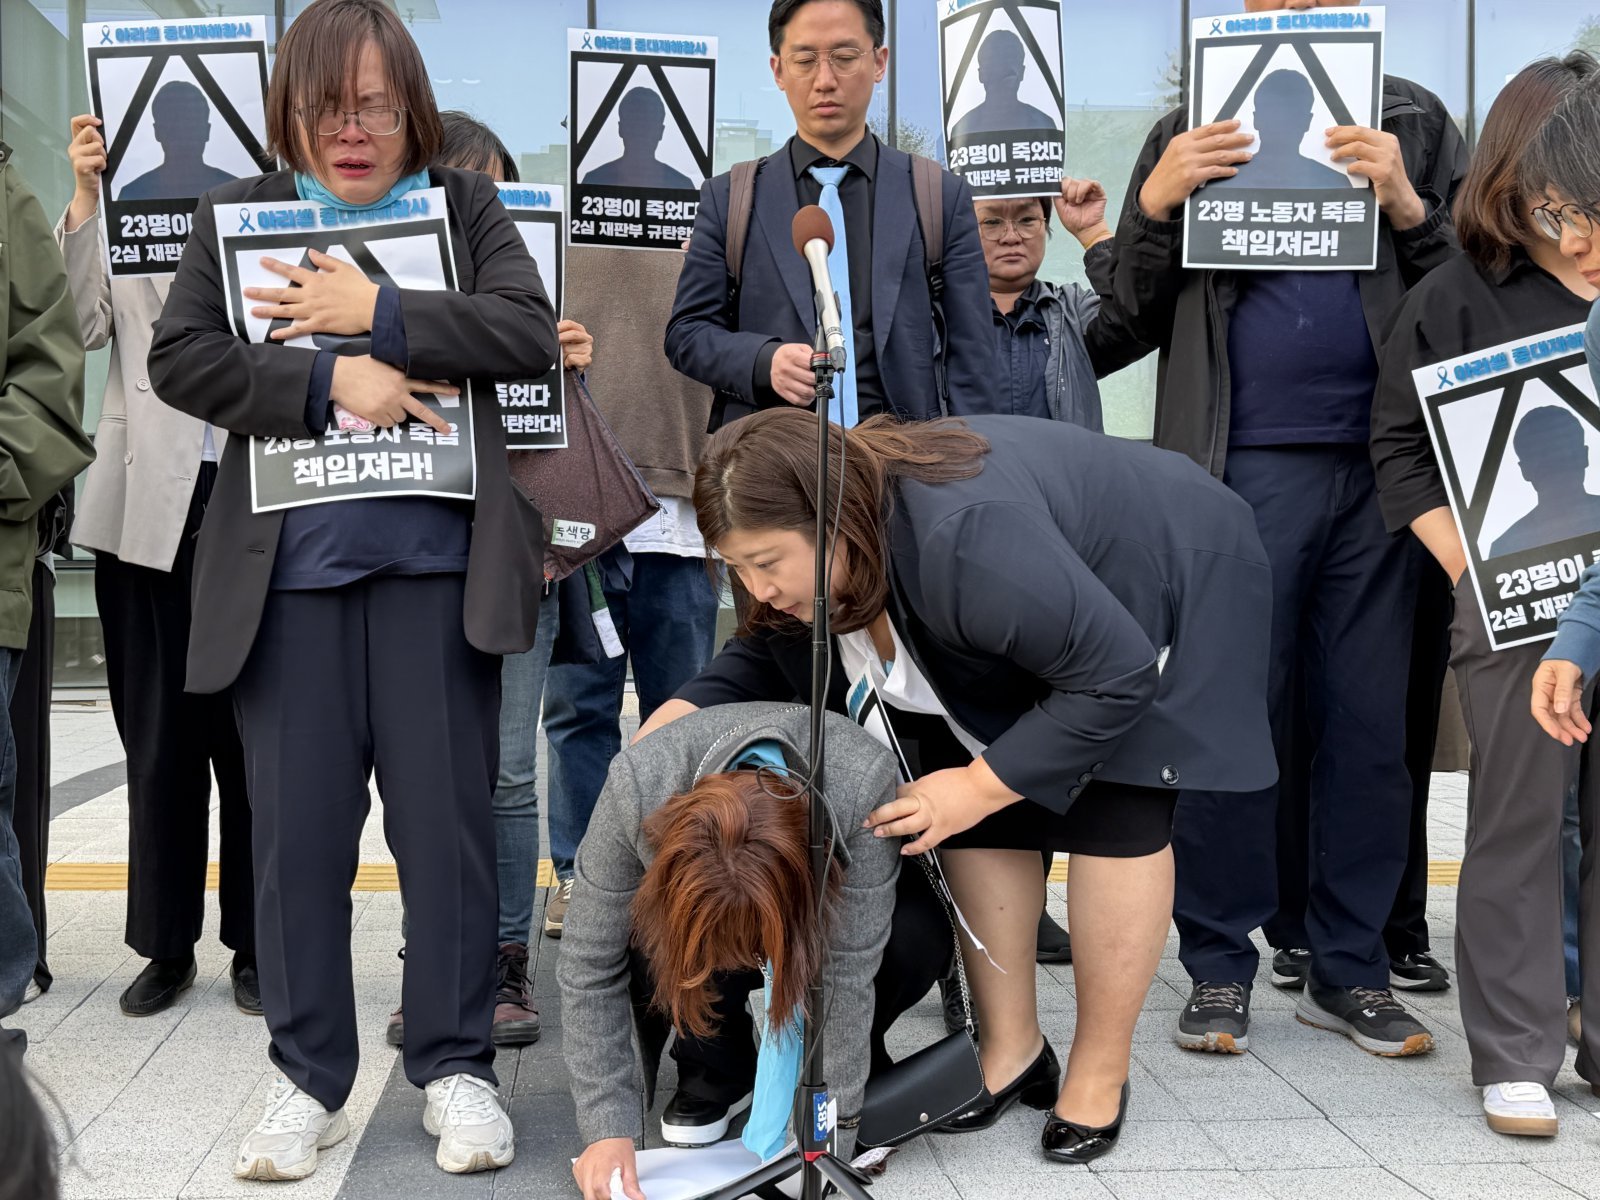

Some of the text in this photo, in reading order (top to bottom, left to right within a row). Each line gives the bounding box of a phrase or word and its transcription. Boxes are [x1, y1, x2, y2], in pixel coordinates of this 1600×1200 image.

[115, 22, 252, 43] 아리셀 중대재해참사
[1226, 13, 1370, 32] 아리셀 중대재해참사
[595, 36, 707, 55] 아리셀 중대재해참사
[950, 141, 1063, 169] 23명이 죽었다
[965, 169, 1011, 187] 재판부
[257, 208, 315, 229] 아리셀
[581, 196, 700, 220] 23명이 죽었다
[1198, 200, 1366, 223] 23명 노동자 죽음
[120, 213, 193, 238] 23명이
[571, 219, 694, 241] 2심 재판부 규탄한
[110, 242, 186, 263] 2심 재판
[1221, 228, 1339, 257] 책임져라!
[1454, 331, 1584, 382] 아리셀 중대재해
[409, 422, 459, 446] 죽음
[501, 414, 562, 433] 탄한다!
[294, 451, 434, 487] 책임져라!
[1496, 554, 1586, 600] 23명이
[1489, 592, 1574, 632] 2심 재판
[817, 1101, 827, 1131] SBS
